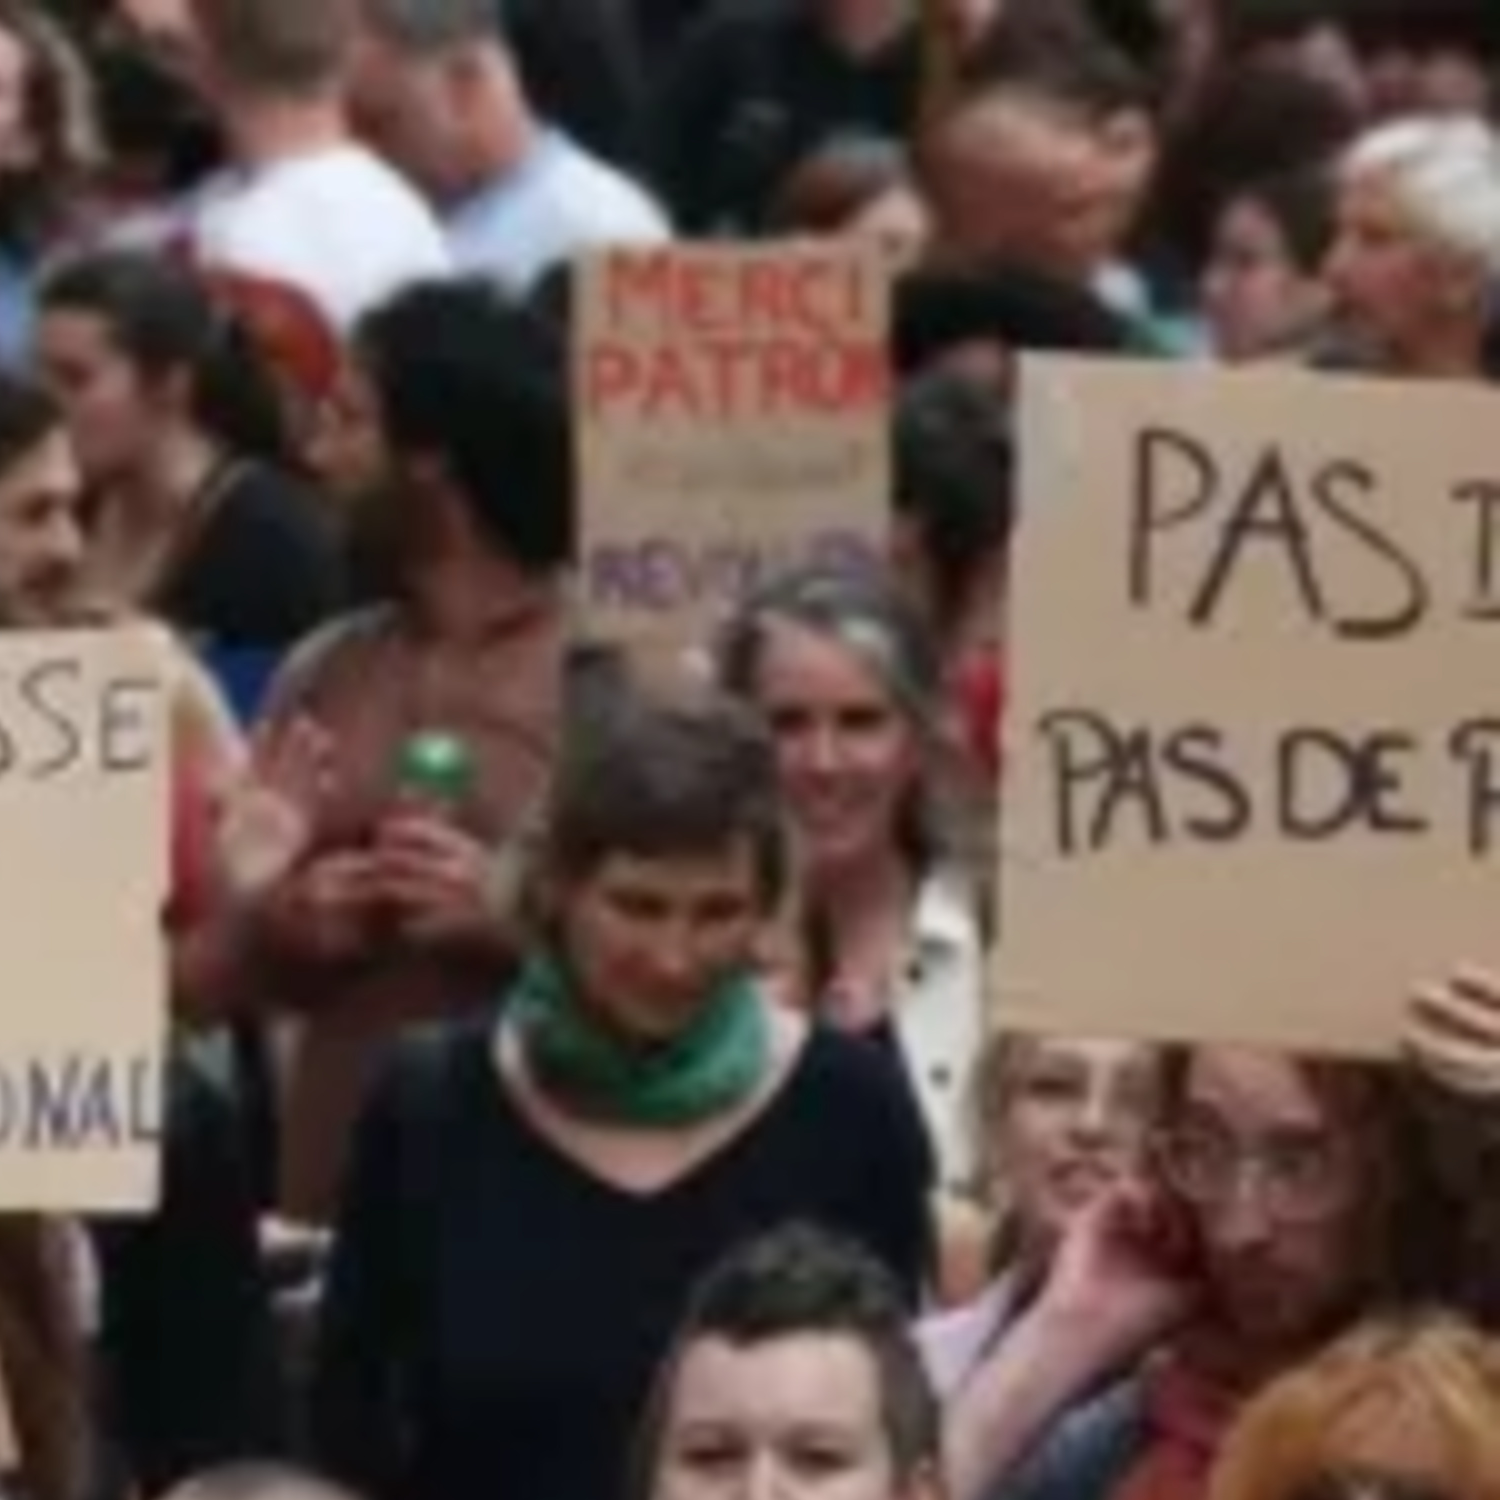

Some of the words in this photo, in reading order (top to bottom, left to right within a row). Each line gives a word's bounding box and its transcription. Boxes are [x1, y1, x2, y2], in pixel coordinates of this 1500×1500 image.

[604, 250, 866, 344] MERCI
[1128, 426, 1426, 640] PAS
[1038, 708, 1250, 856] PAS
[1278, 726, 1430, 842] DE
